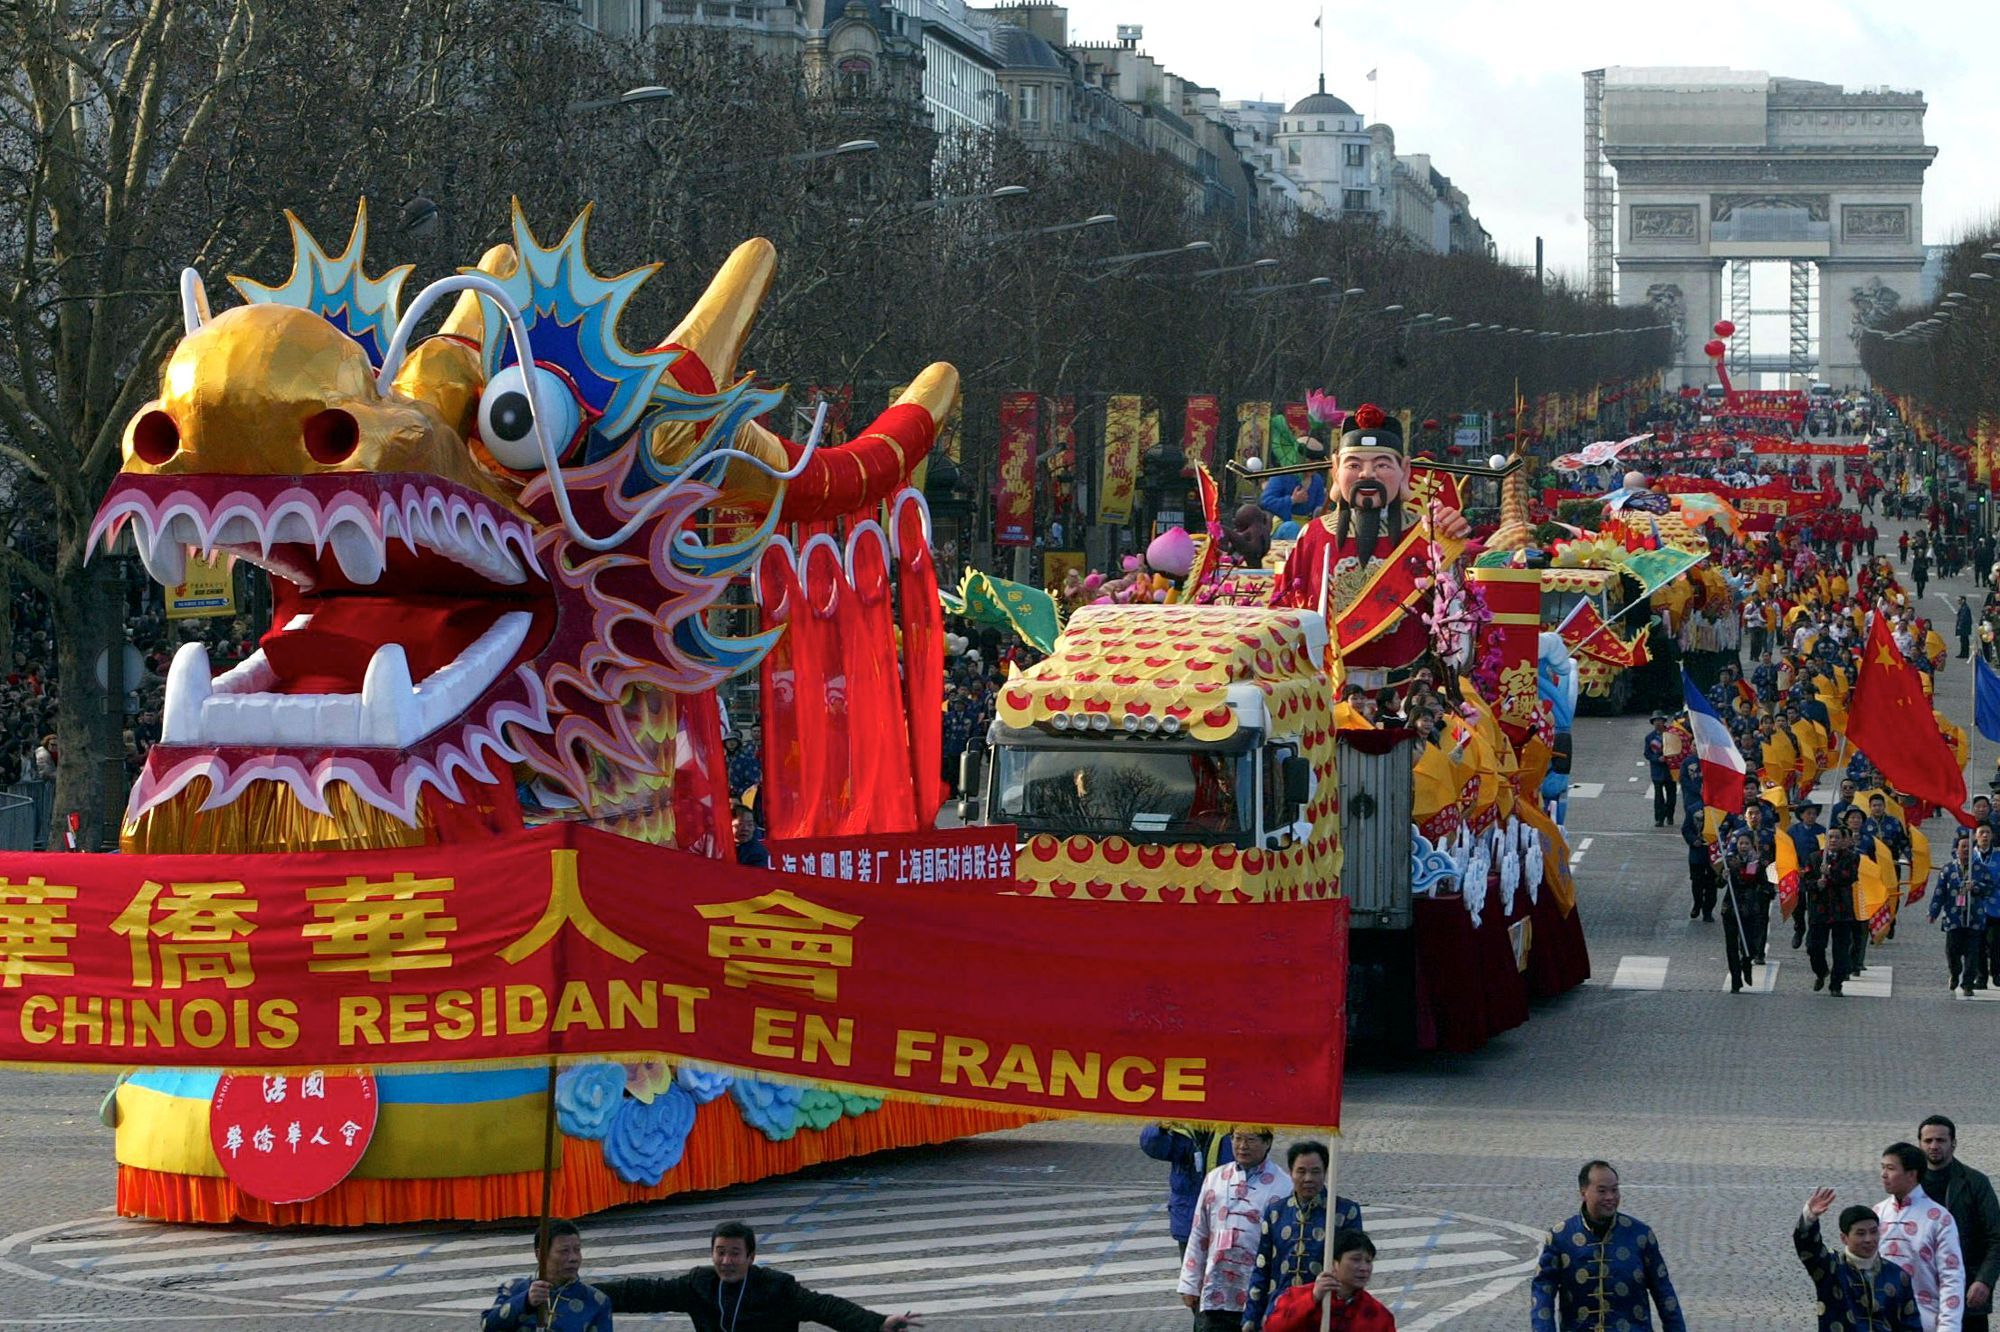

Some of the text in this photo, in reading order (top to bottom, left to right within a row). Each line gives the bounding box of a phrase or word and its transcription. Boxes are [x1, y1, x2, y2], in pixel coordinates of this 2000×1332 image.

[896, 842, 1012, 885] 上海国际时尚联合会
[20, 979, 1206, 1103] CHINOIS RESIDANT EN FRANCE
